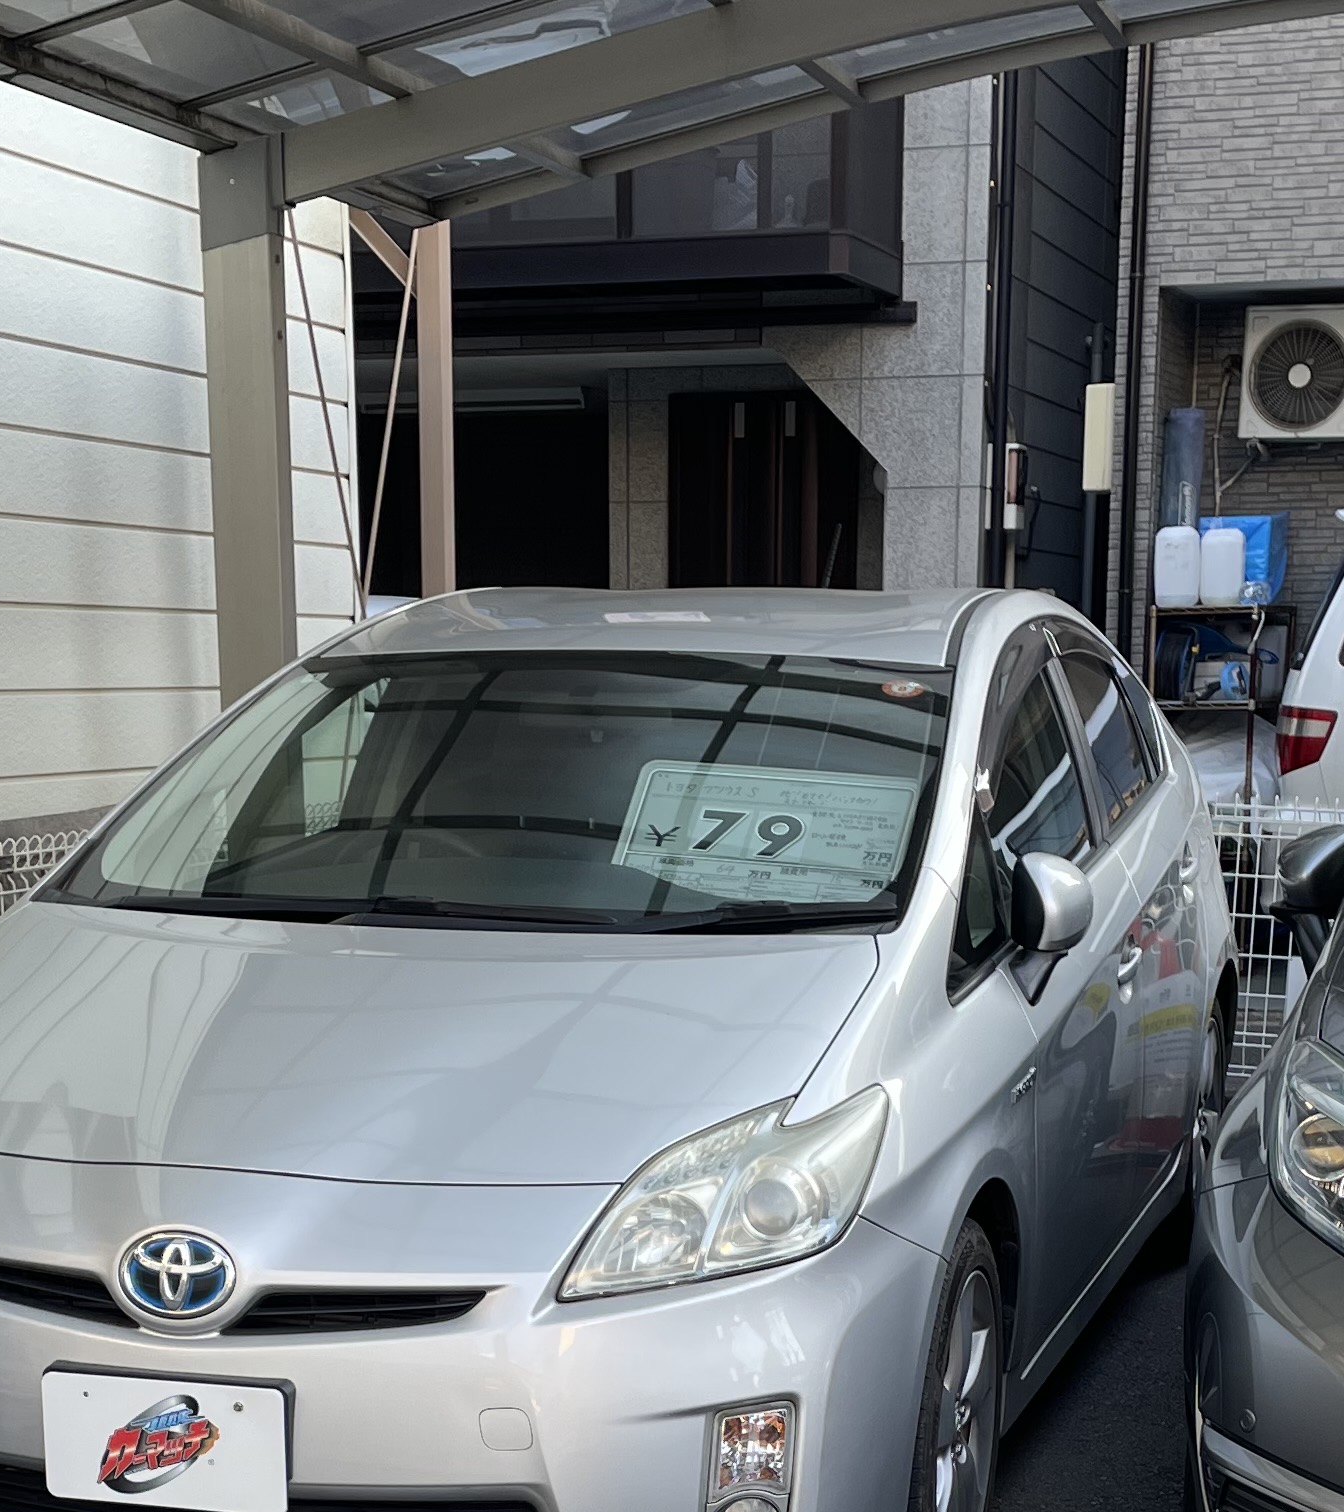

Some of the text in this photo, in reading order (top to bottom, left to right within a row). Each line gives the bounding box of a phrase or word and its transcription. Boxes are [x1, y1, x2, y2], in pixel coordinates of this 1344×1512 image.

[689, 808, 806, 858] 79
[862, 851, 894, 863] 万円
[747, 869, 772, 880] 万円
[97, 1418, 210, 1485] カーマッチ
